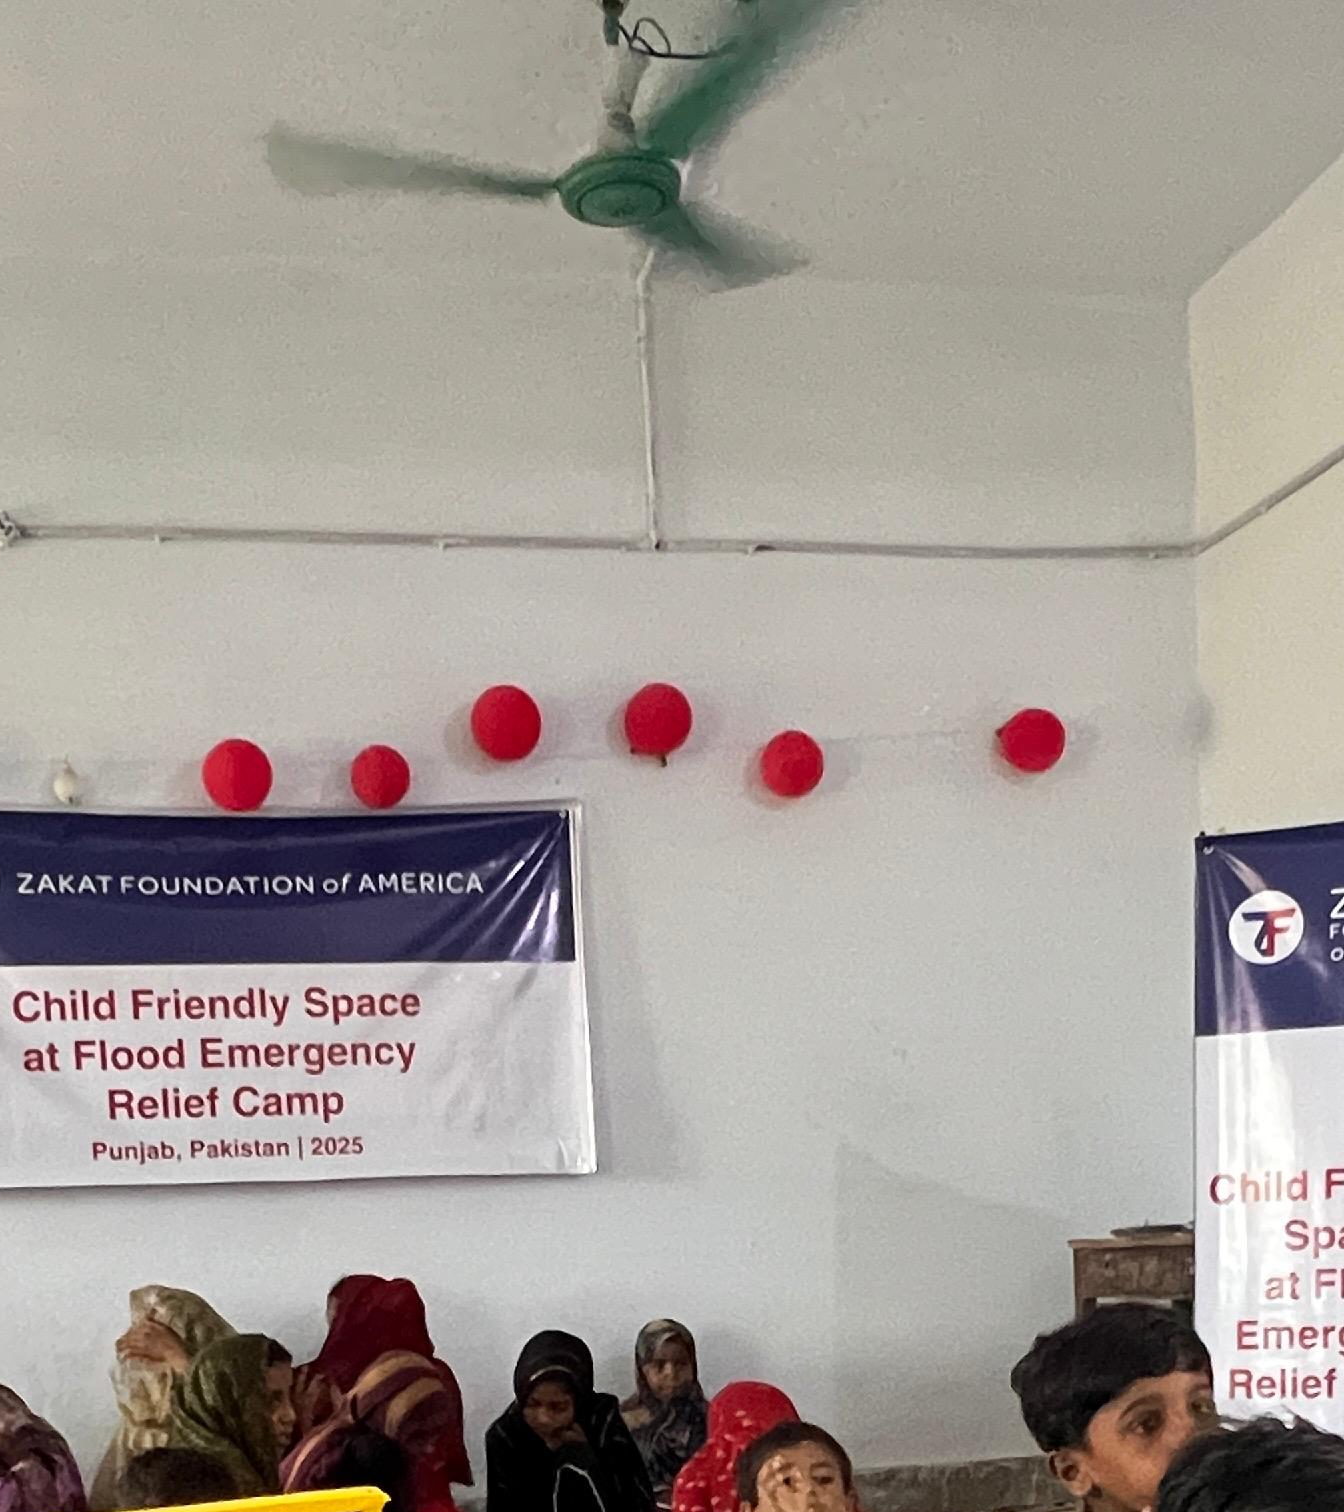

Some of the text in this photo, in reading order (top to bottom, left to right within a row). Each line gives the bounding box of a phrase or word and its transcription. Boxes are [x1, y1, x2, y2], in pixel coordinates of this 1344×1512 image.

[16, 871, 484, 896] ZAKAT FOUNDATION of AMERICA
[11, 985, 423, 1024] Child Friendly Space
[22, 1038, 417, 1075] at Flood Emergency
[106, 1086, 347, 1123] Relief Camp
[89, 1140, 182, 1164] Punjab,
[188, 1139, 291, 1159] Pakistan
[311, 1136, 365, 1157] 2025
[1207, 1170, 1311, 1205] Child
[1264, 1269, 1302, 1302] at
[1229, 1366, 1337, 1400] Relief
